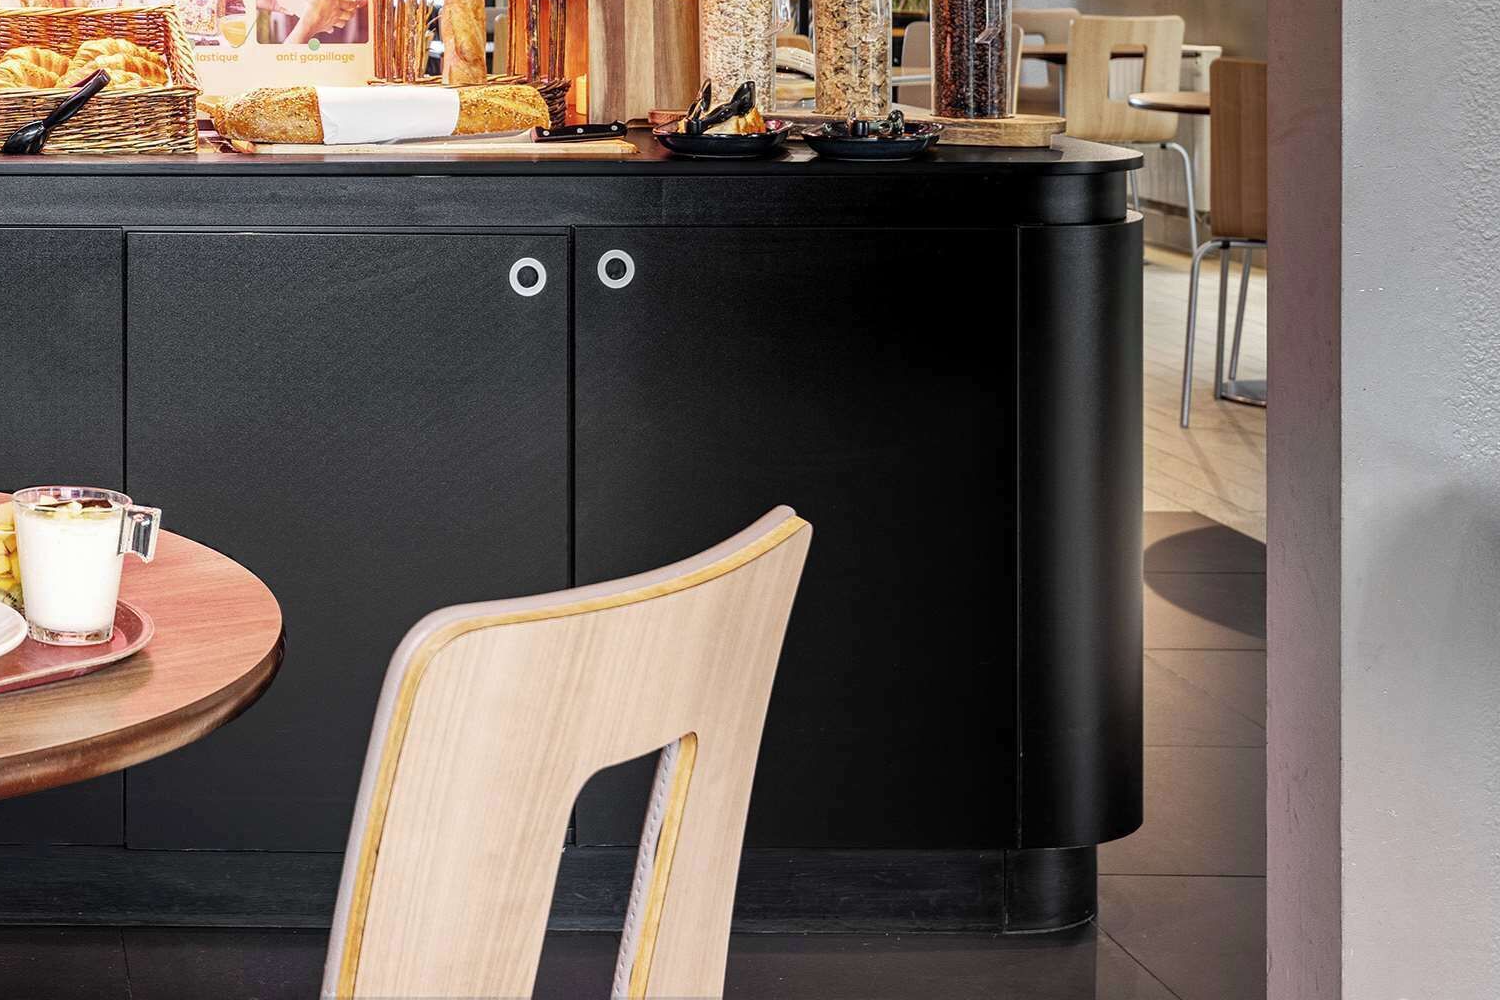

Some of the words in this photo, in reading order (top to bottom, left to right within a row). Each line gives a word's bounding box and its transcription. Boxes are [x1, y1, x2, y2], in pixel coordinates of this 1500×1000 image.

[196, 52, 239, 64] lastique
[276, 51, 297, 62] anti
[299, 51, 356, 64] gaspillage
